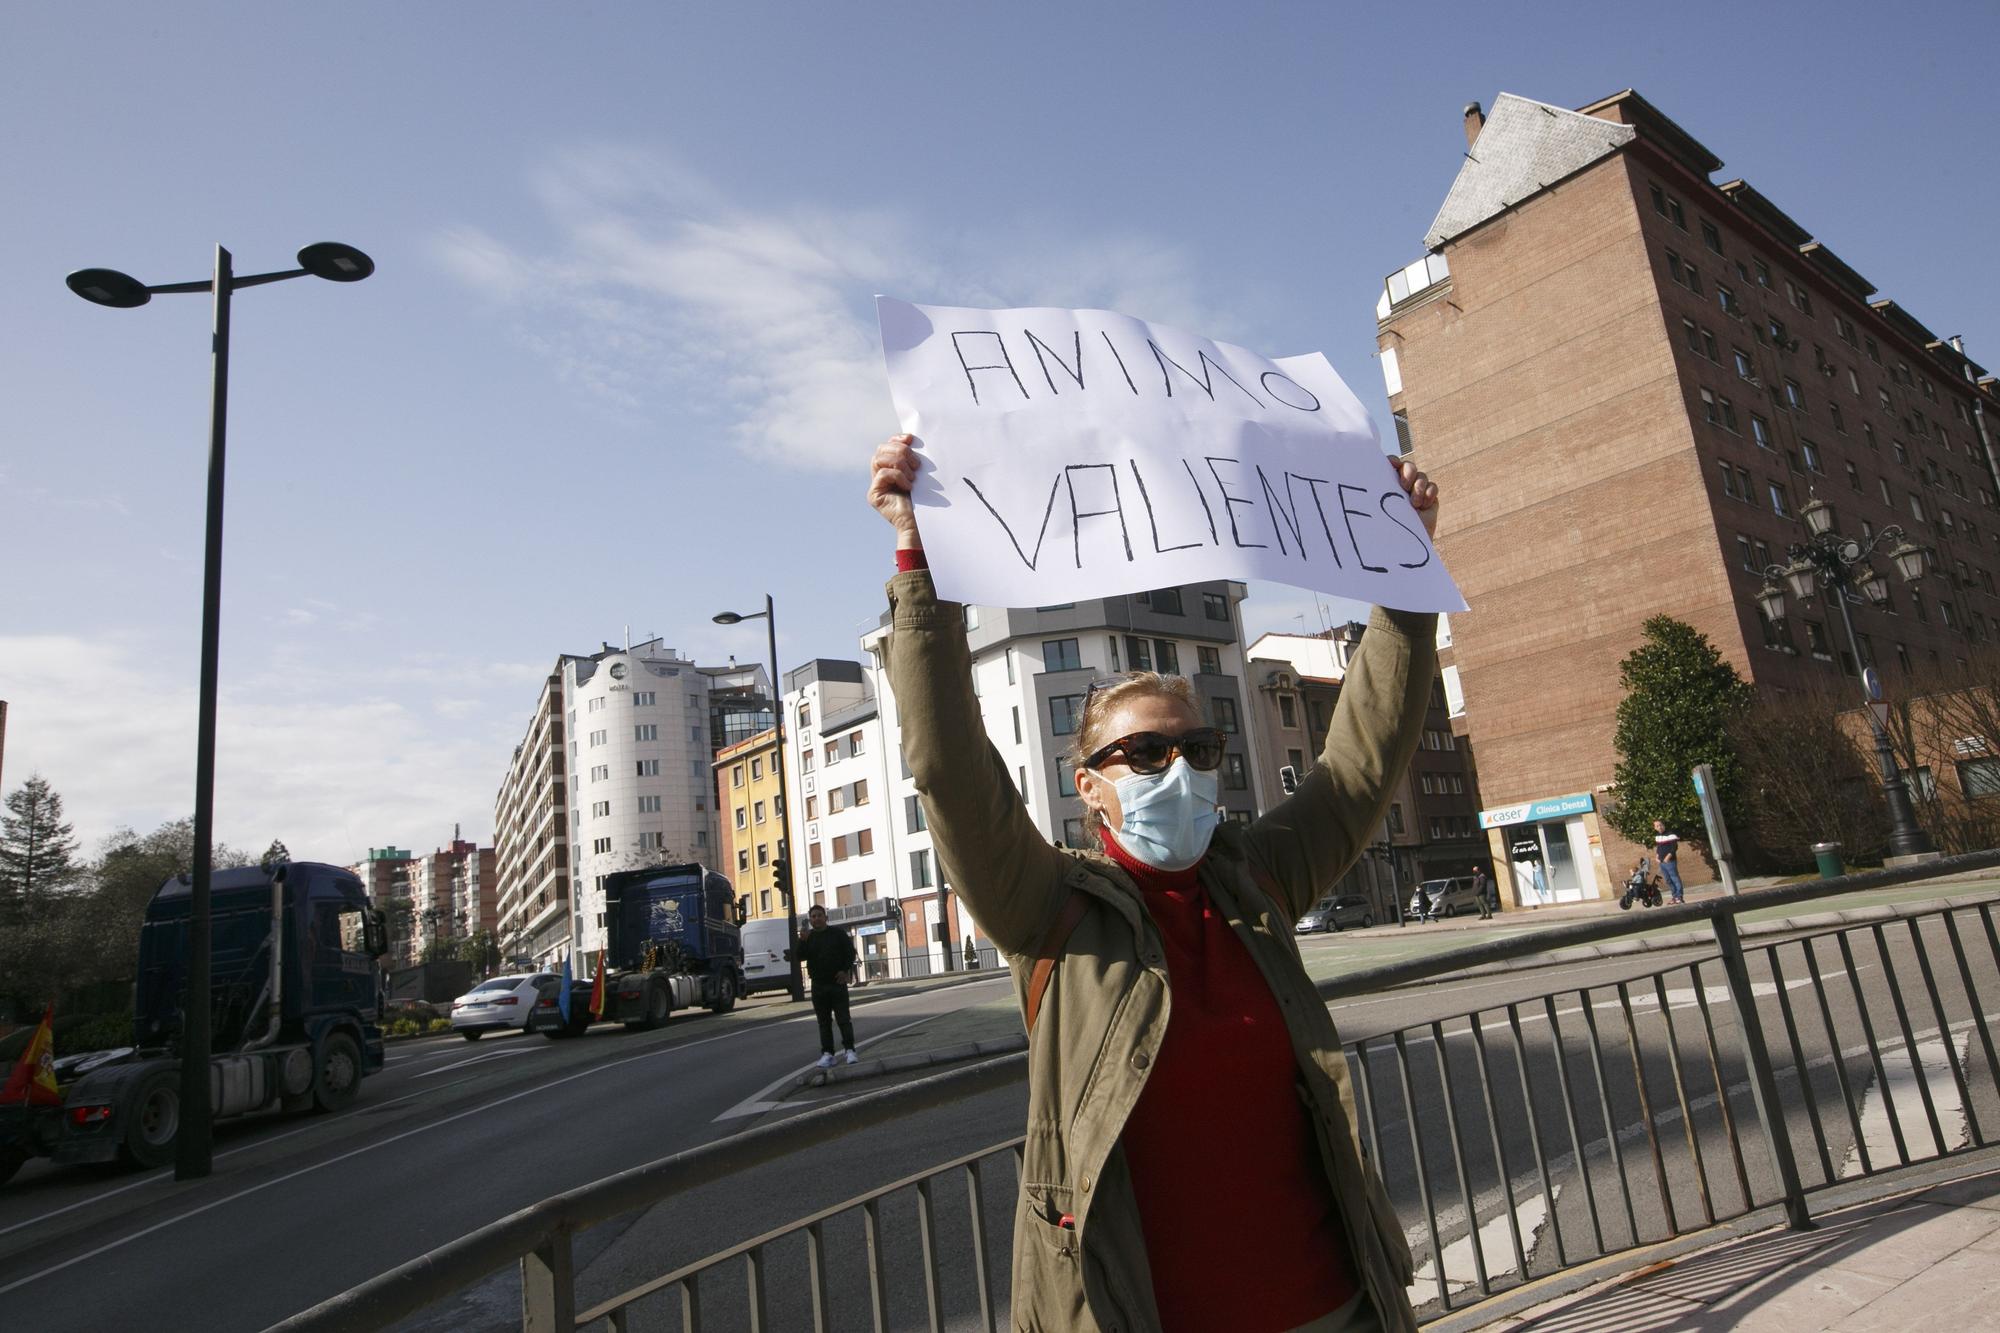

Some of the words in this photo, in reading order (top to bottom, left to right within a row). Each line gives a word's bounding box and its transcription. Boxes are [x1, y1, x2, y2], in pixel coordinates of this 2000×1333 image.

[951, 328, 1321, 412] ANIMO
[962, 455, 1430, 574] VALIENTES
[1493, 808, 1522, 823] caser
[1561, 798, 1588, 811] Dental
